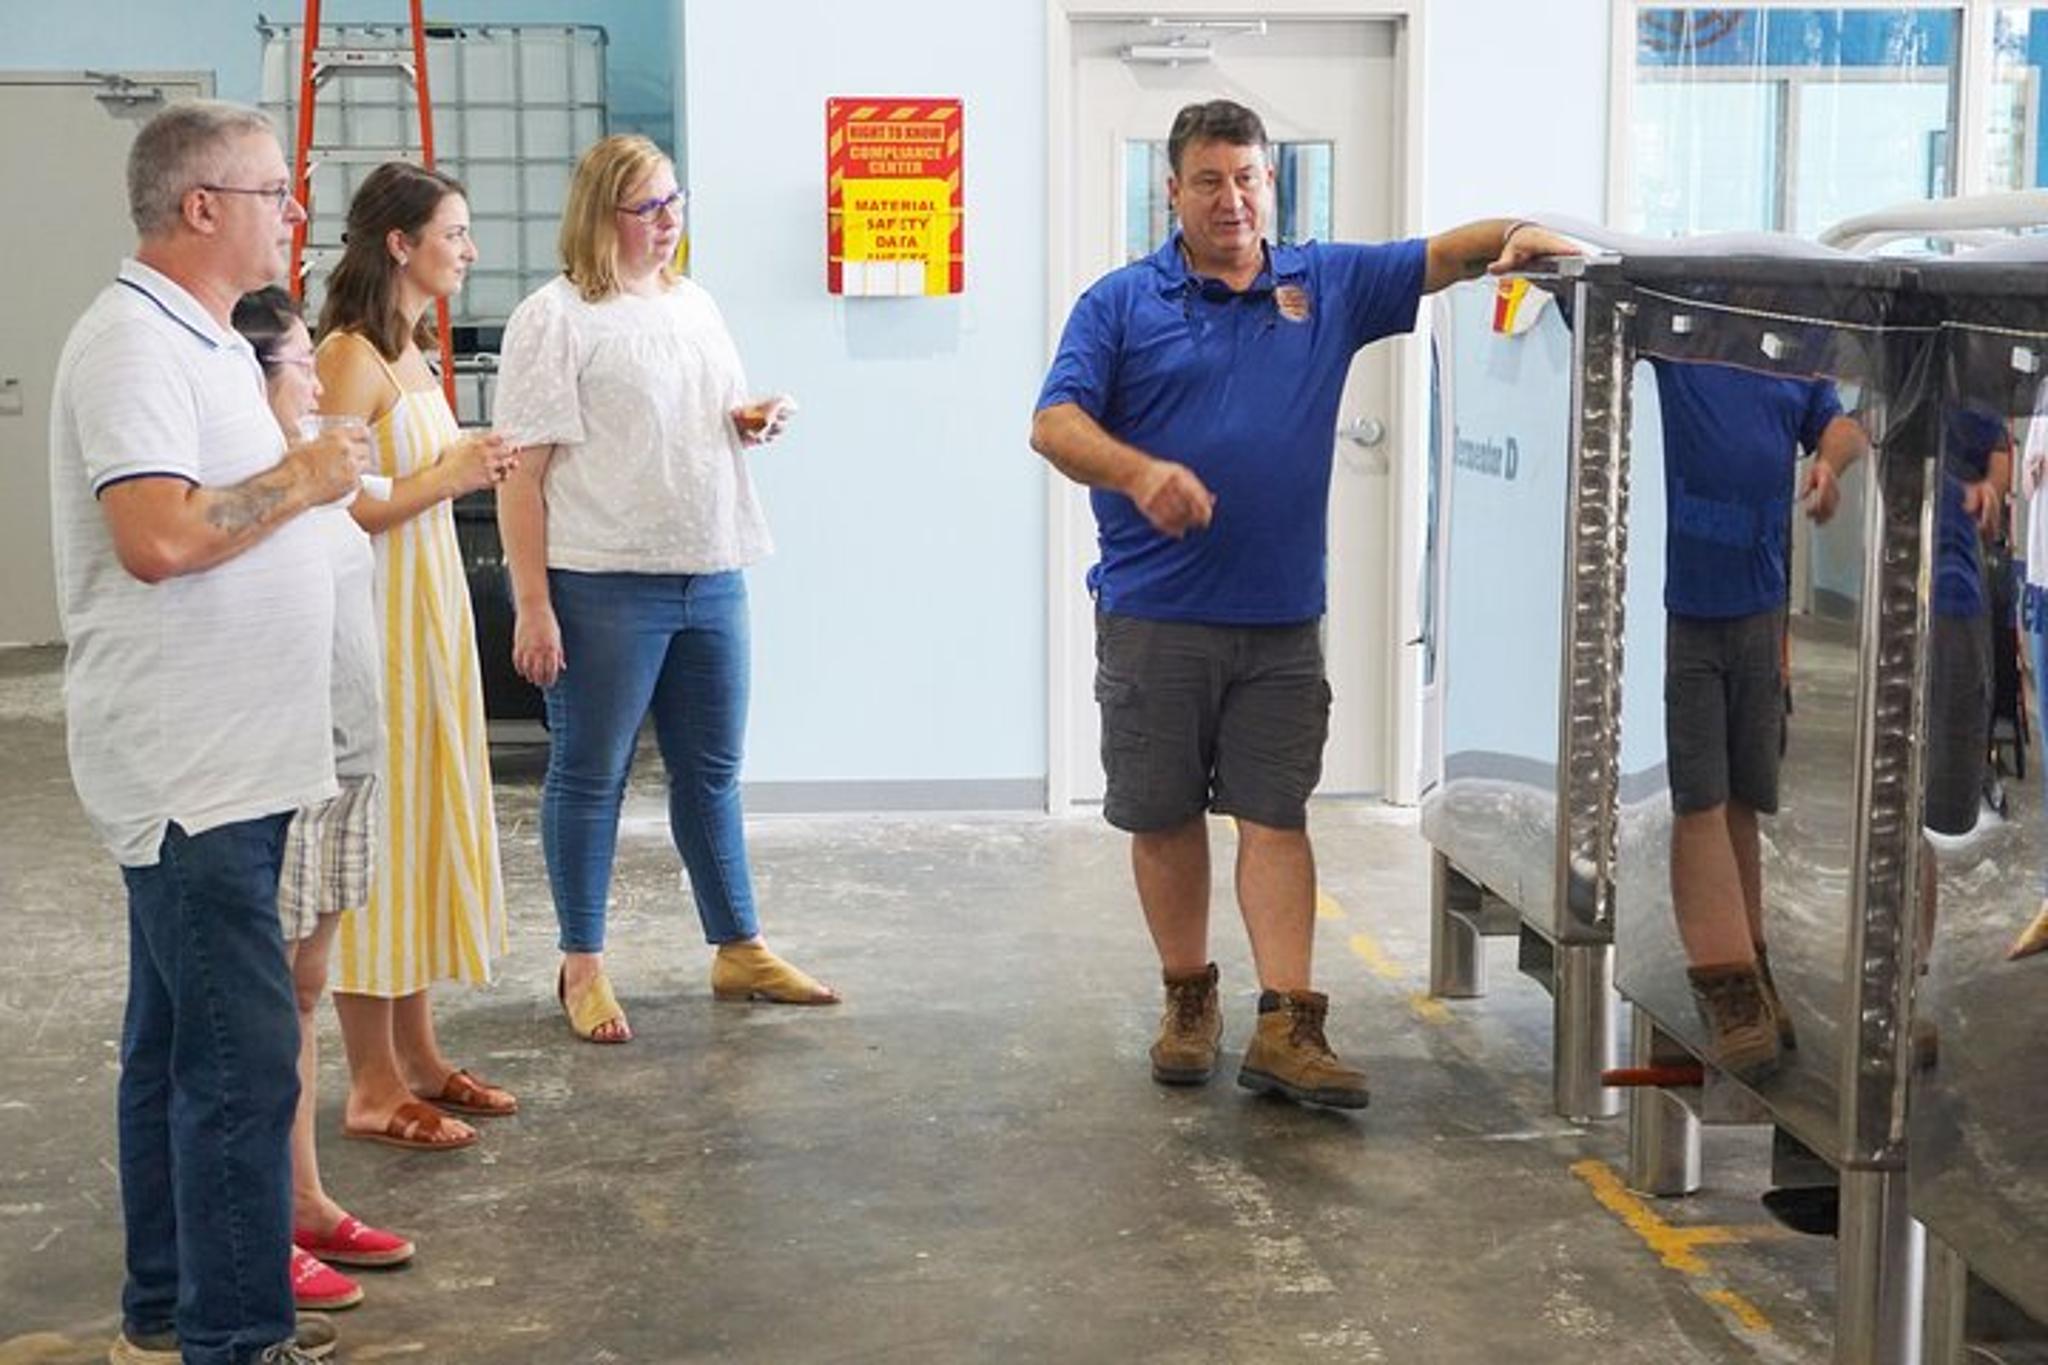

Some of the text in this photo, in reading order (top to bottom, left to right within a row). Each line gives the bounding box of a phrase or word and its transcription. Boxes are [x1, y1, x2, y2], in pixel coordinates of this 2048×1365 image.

[855, 200, 934, 211] MATERIAL
[867, 218, 929, 231] SAFETY
[875, 235, 918, 248] DATA
[1504, 437, 1519, 480] D
